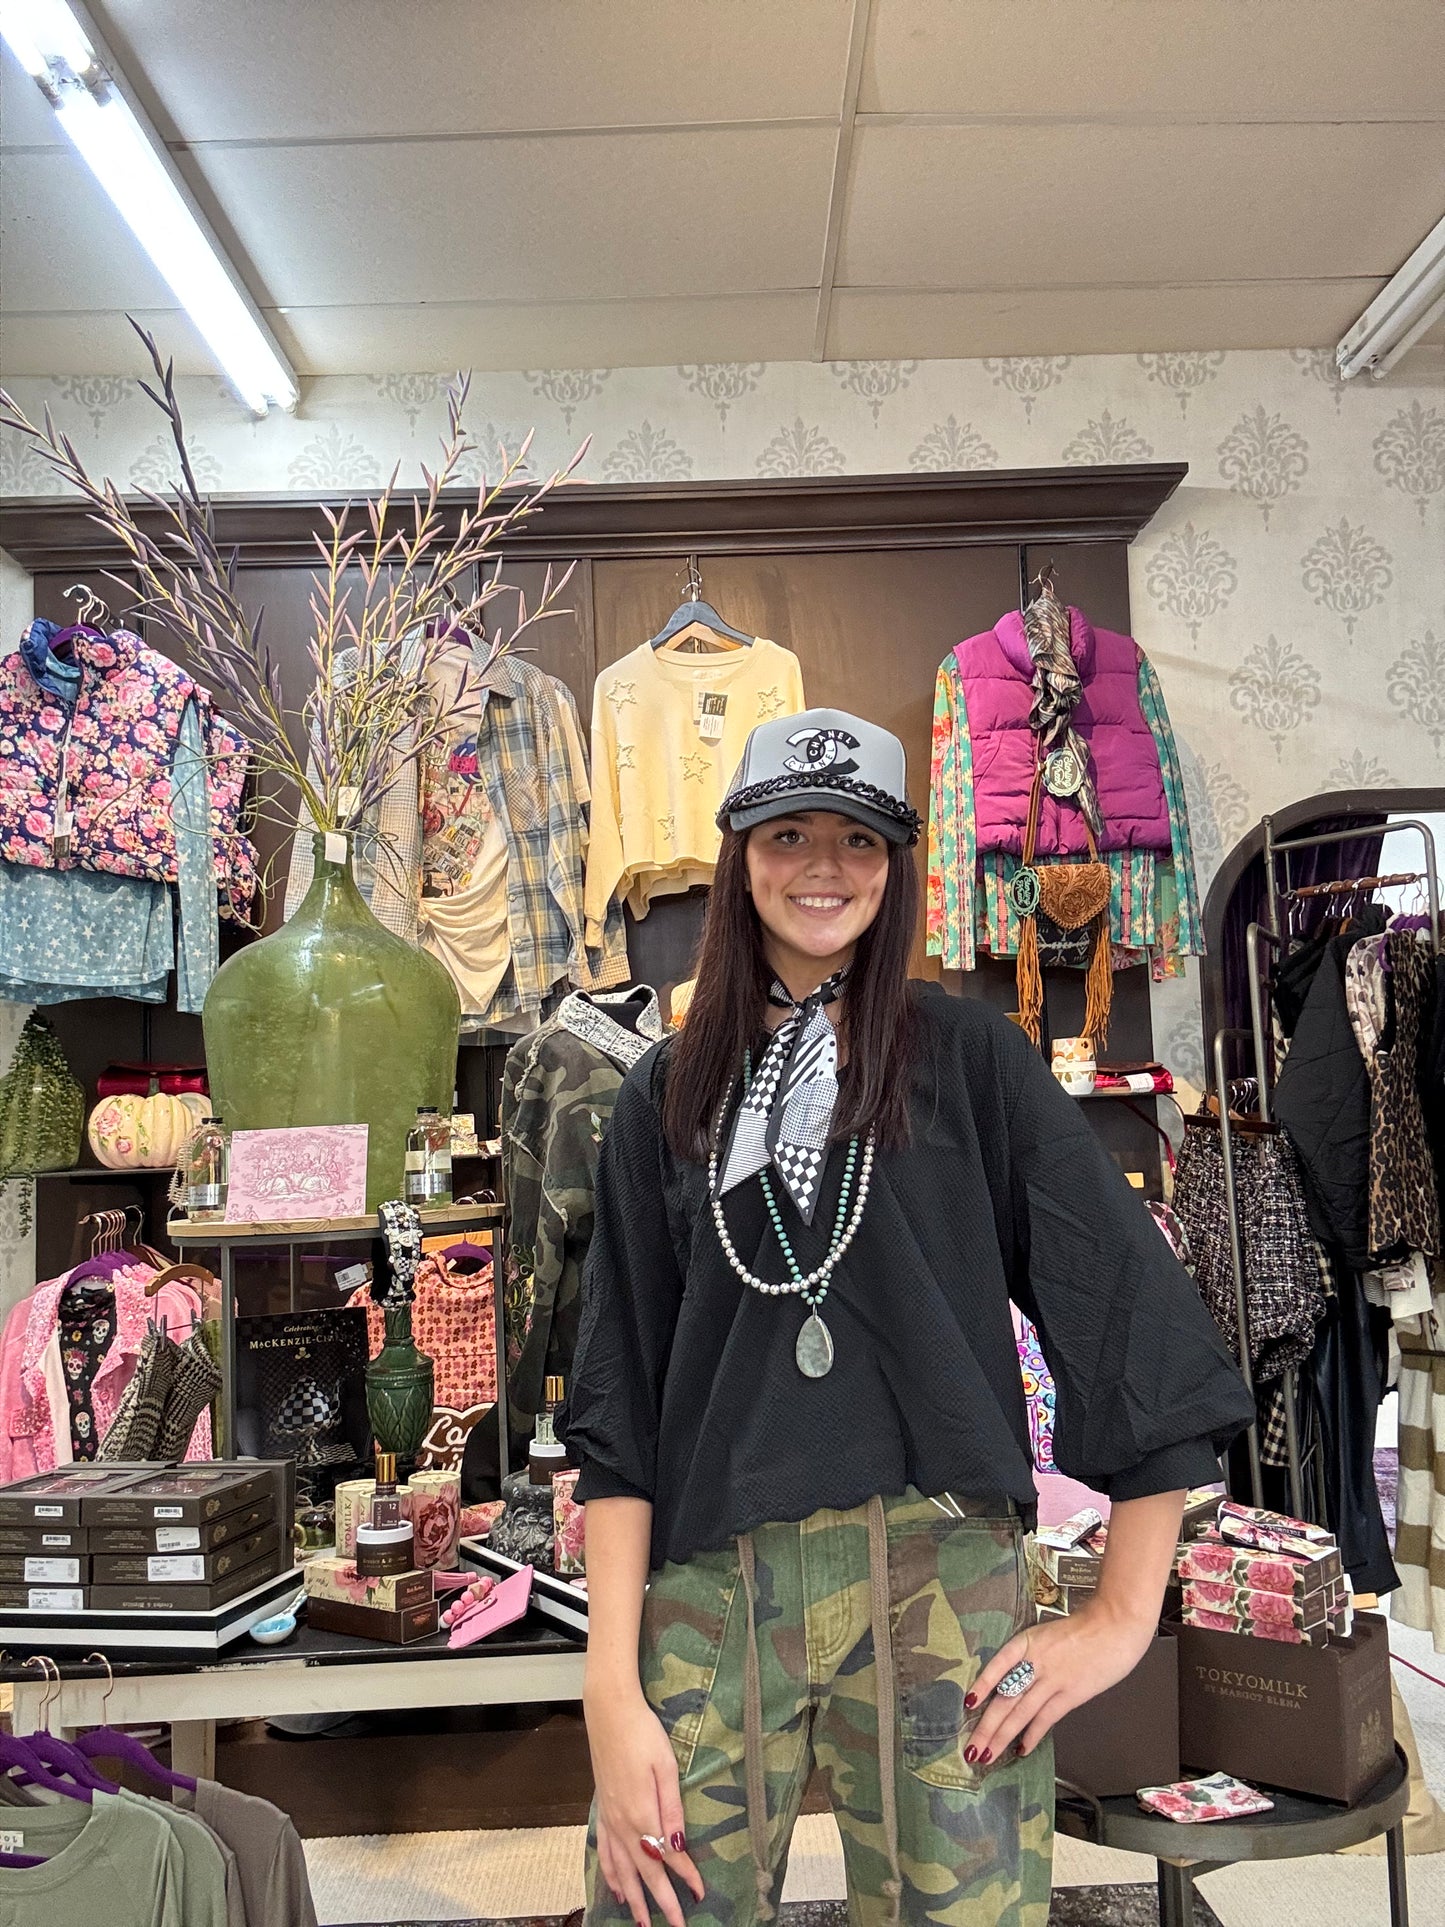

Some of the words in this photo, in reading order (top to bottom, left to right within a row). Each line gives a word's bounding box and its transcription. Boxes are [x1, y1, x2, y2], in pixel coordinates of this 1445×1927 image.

[809, 731, 852, 756] CHANEL
[788, 748, 834, 770] CHANEL
[1196, 1666, 1308, 1698] TOKYOMILK
[1219, 1687, 1264, 1702] MARGOT
[1267, 1696, 1301, 1709] ELENA
